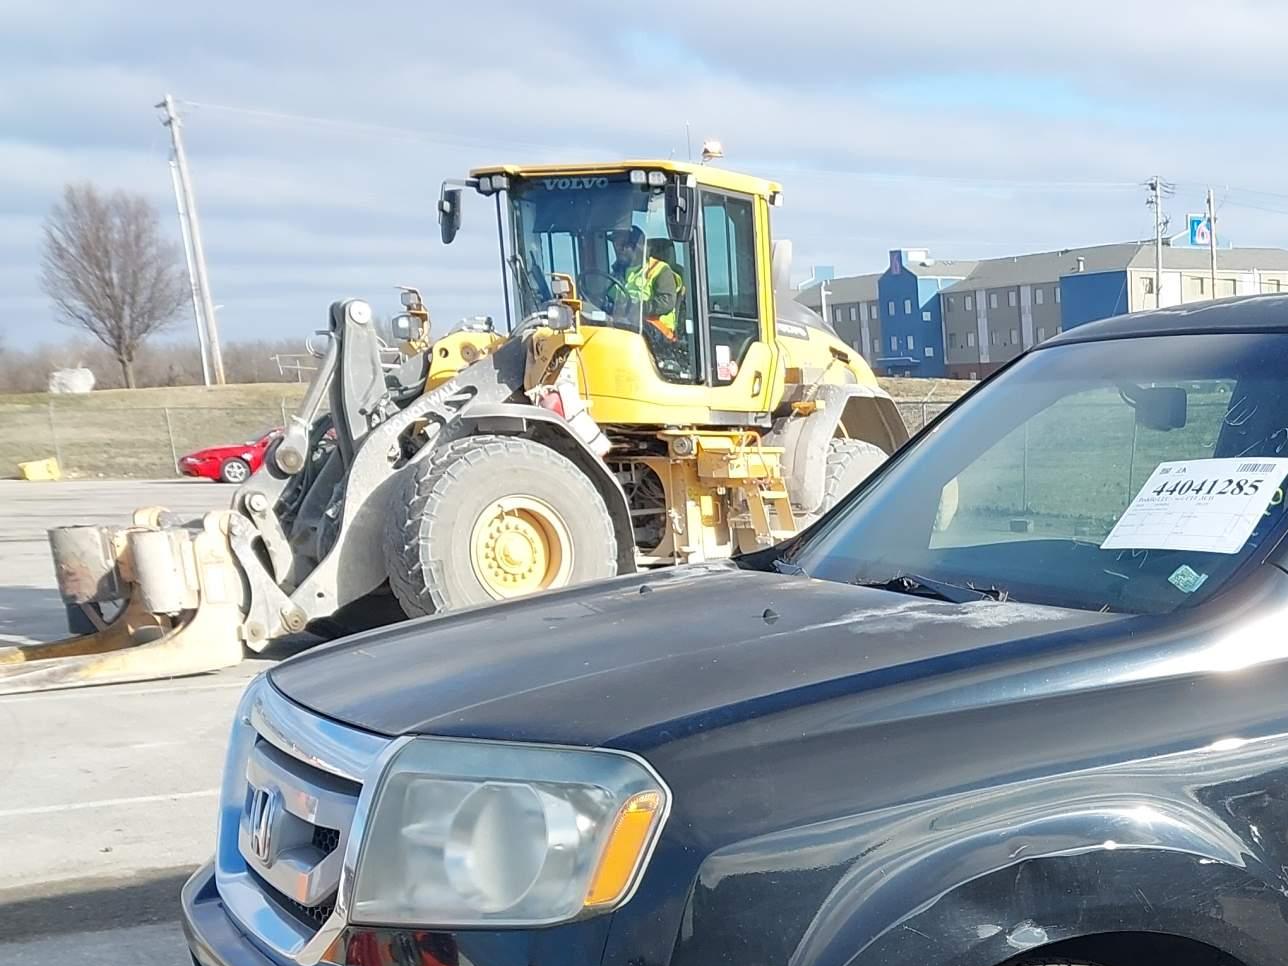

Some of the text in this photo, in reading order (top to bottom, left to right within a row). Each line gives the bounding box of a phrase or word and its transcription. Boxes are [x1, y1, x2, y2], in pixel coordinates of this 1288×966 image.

[543, 177, 609, 190] VOLVO
[402, 401, 428, 420] NOT
[427, 381, 461, 406] WALK
[1152, 479, 1265, 496] 44041285
